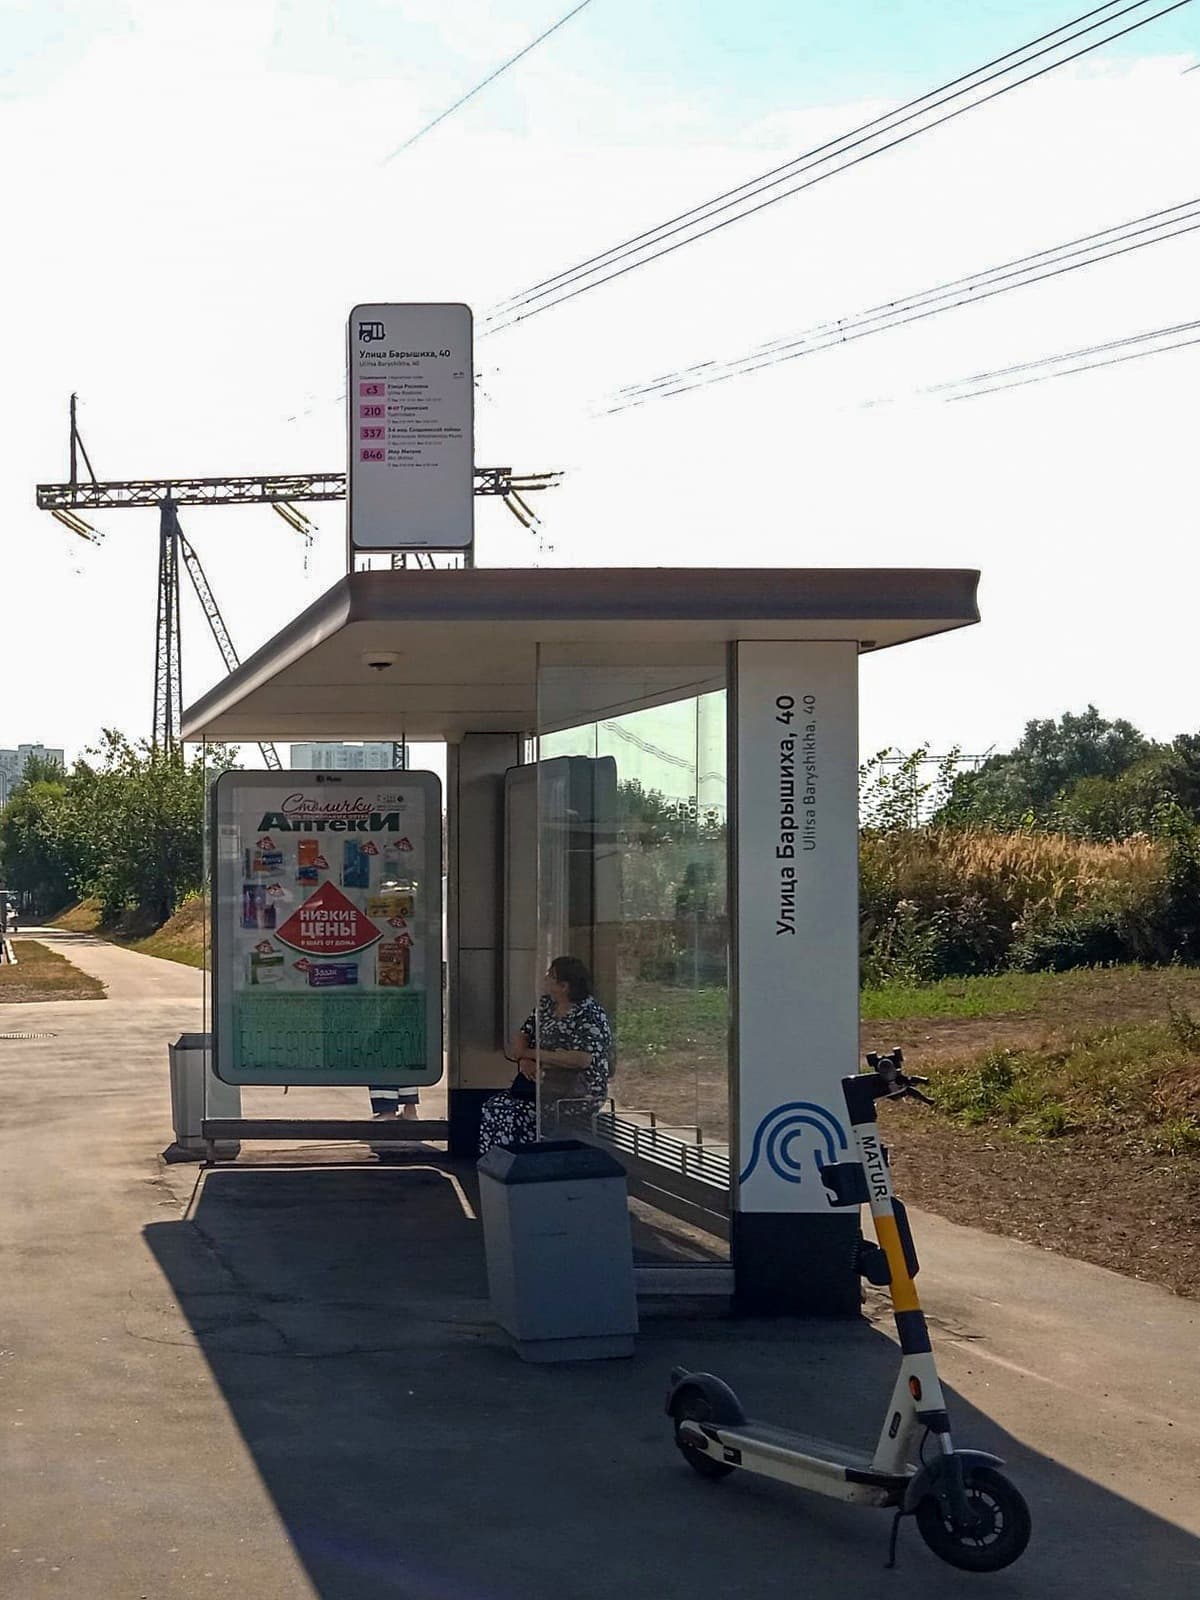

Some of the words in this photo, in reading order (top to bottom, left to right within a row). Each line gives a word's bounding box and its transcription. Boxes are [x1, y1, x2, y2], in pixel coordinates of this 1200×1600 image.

[360, 350, 387, 359] Улица
[389, 350, 438, 360] Барышиха,
[439, 350, 451, 358] 40
[363, 407, 381, 417] 210
[363, 428, 382, 438] 337
[362, 450, 383, 460] 846
[776, 695, 795, 725] 40
[803, 694, 817, 714] 40
[803, 719, 819, 805] Baryshikha,
[280, 793, 375, 814] Столички
[776, 732, 799, 860] Барышиха,
[803, 809, 817, 851] Ulitsa
[776, 866, 798, 936] Улица
[300, 910, 357, 921] НИЗКИЕ
[301, 922, 357, 939] ЦЕНЫ
